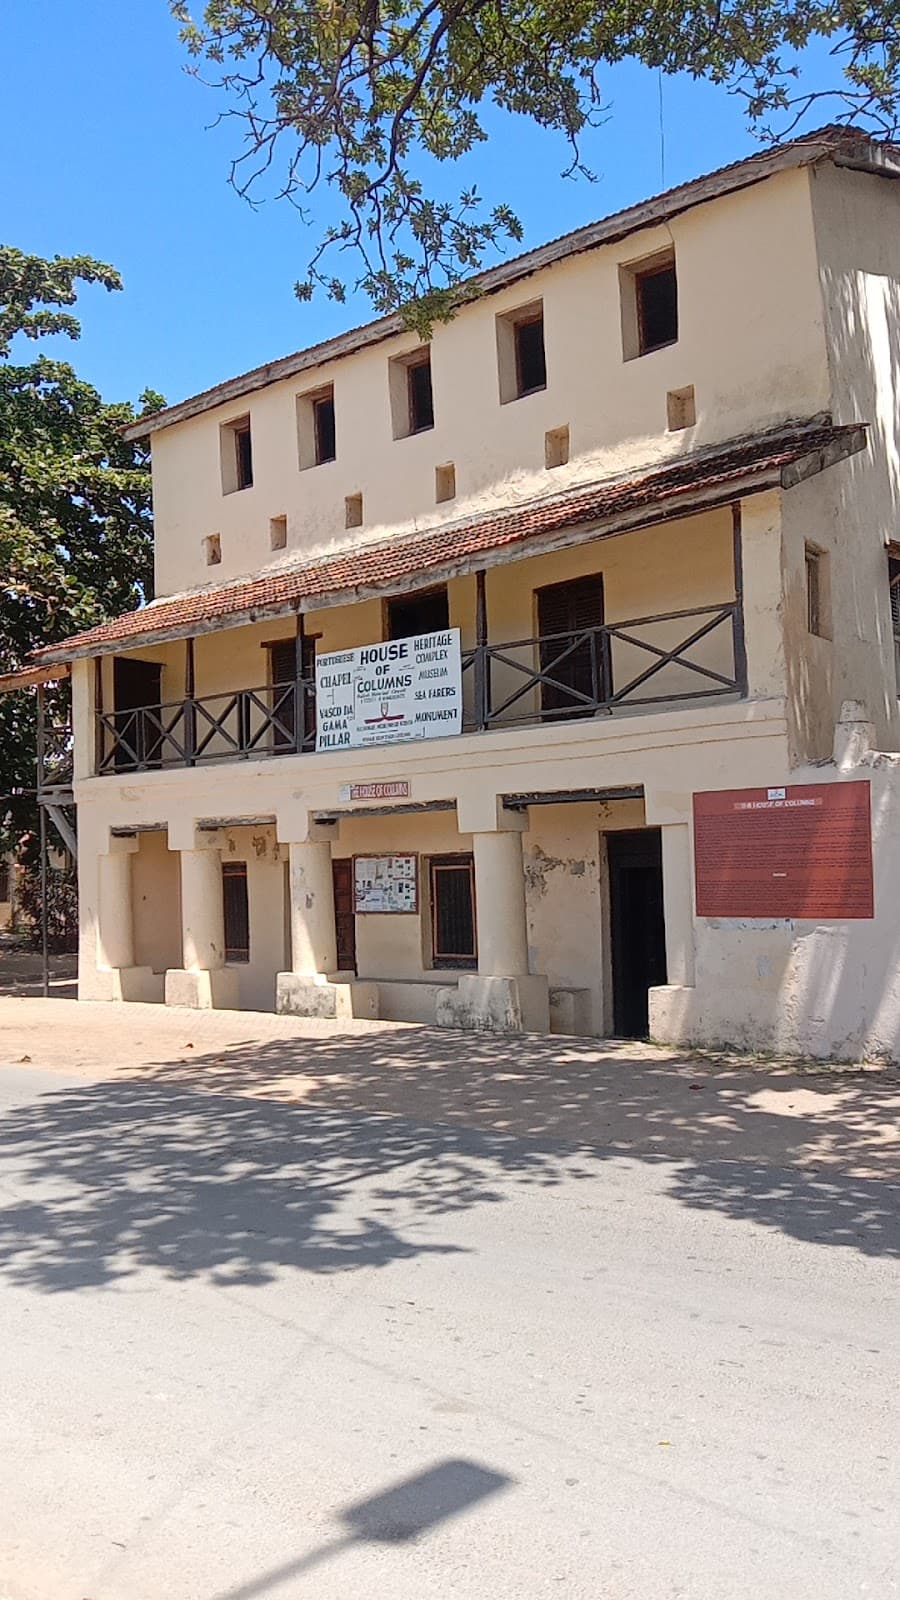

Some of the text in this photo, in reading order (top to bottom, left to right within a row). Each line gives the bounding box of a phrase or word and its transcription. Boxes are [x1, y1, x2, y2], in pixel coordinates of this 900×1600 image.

[414, 634, 452, 651] HERITAGE
[361, 643, 408, 665] HOUSE
[416, 650, 448, 664] COMPLEX
[376, 664, 390, 676] OF
[418, 667, 448, 680] MUSEUM
[321, 672, 351, 688] CHAPEL
[357, 675, 412, 693] COLUMNS
[320, 707, 341, 719] VASCO
[344, 705, 353, 716] DA
[415, 709, 457, 721] MONUMENT
[323, 719, 347, 732] GAMA
[320, 732, 350, 748] PILLAR
